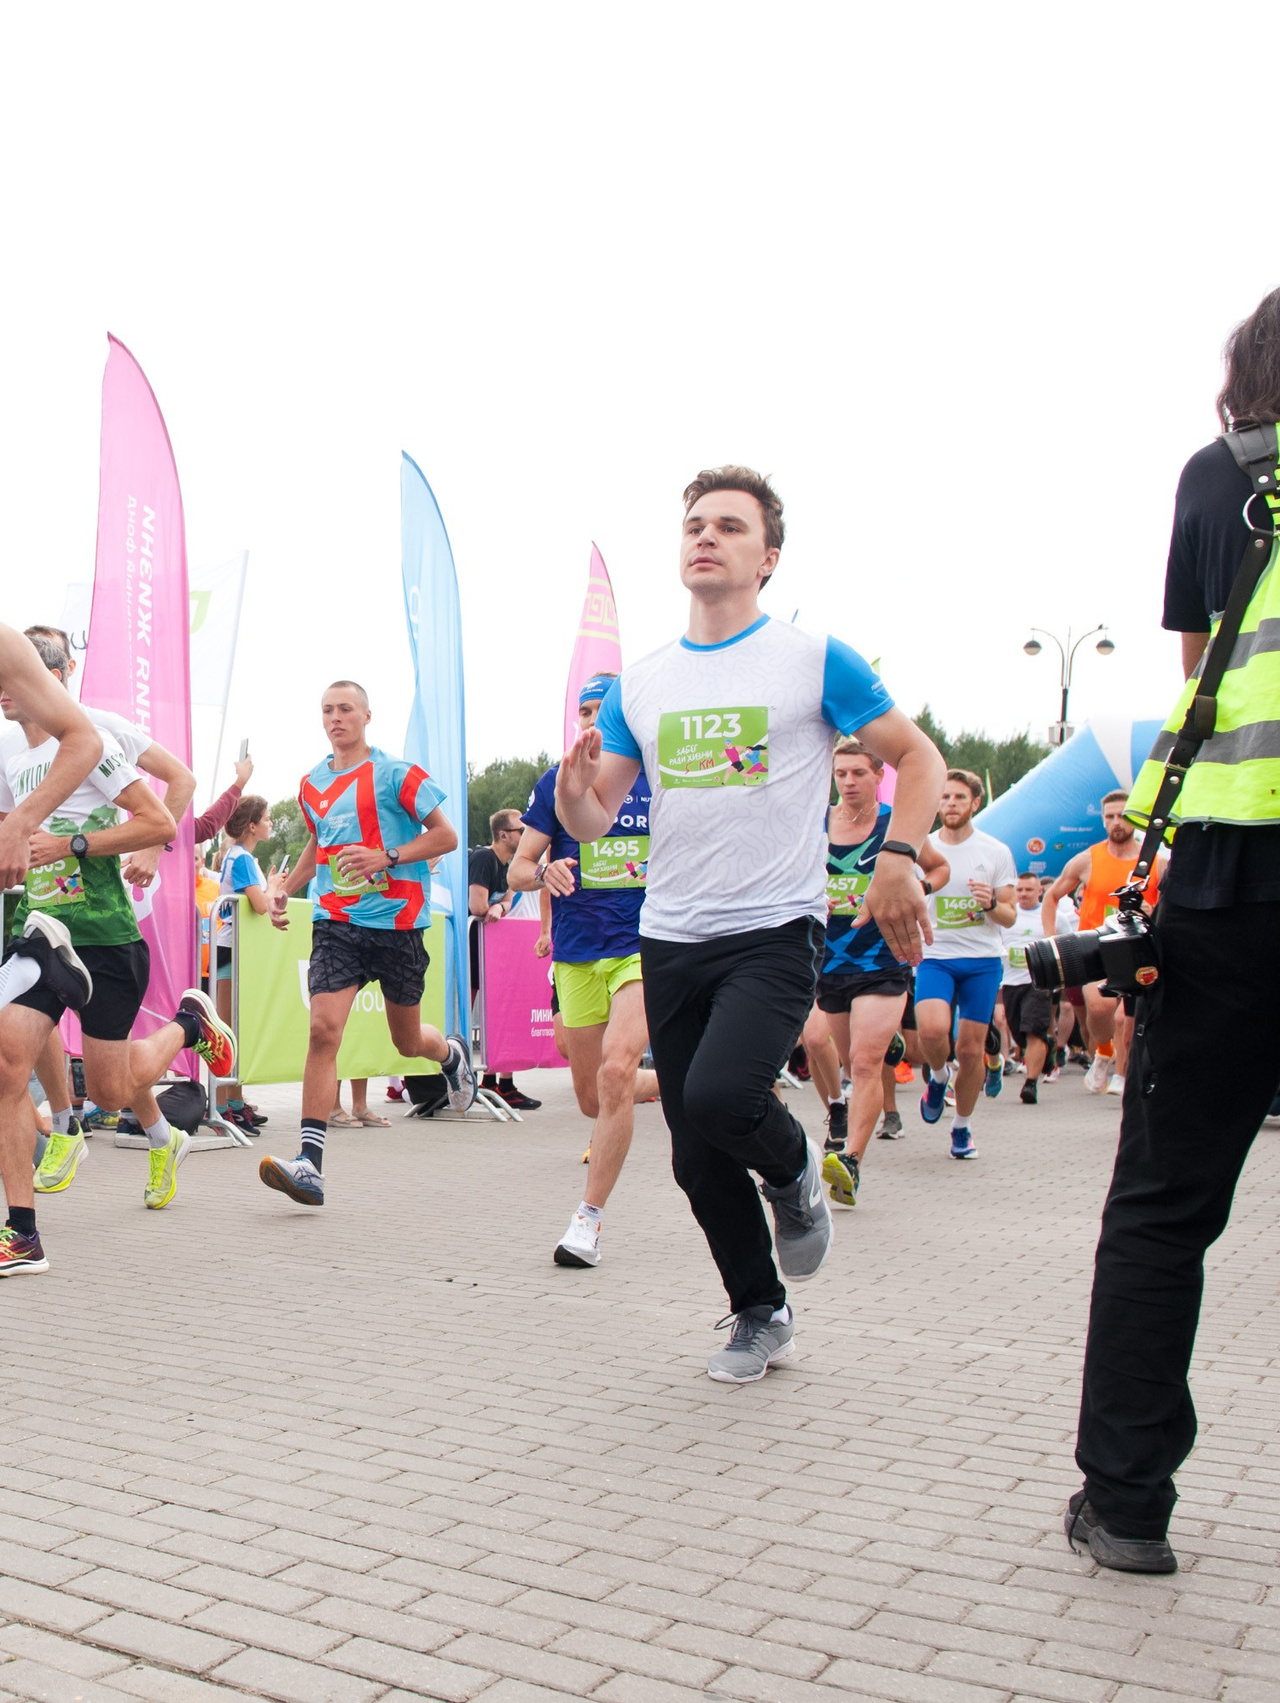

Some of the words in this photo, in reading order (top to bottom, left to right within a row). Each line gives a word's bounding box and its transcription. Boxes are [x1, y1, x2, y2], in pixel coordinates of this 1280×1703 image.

[680, 713, 742, 740] 1123
[590, 840, 640, 857] 1495
[943, 898, 977, 910] 1460
